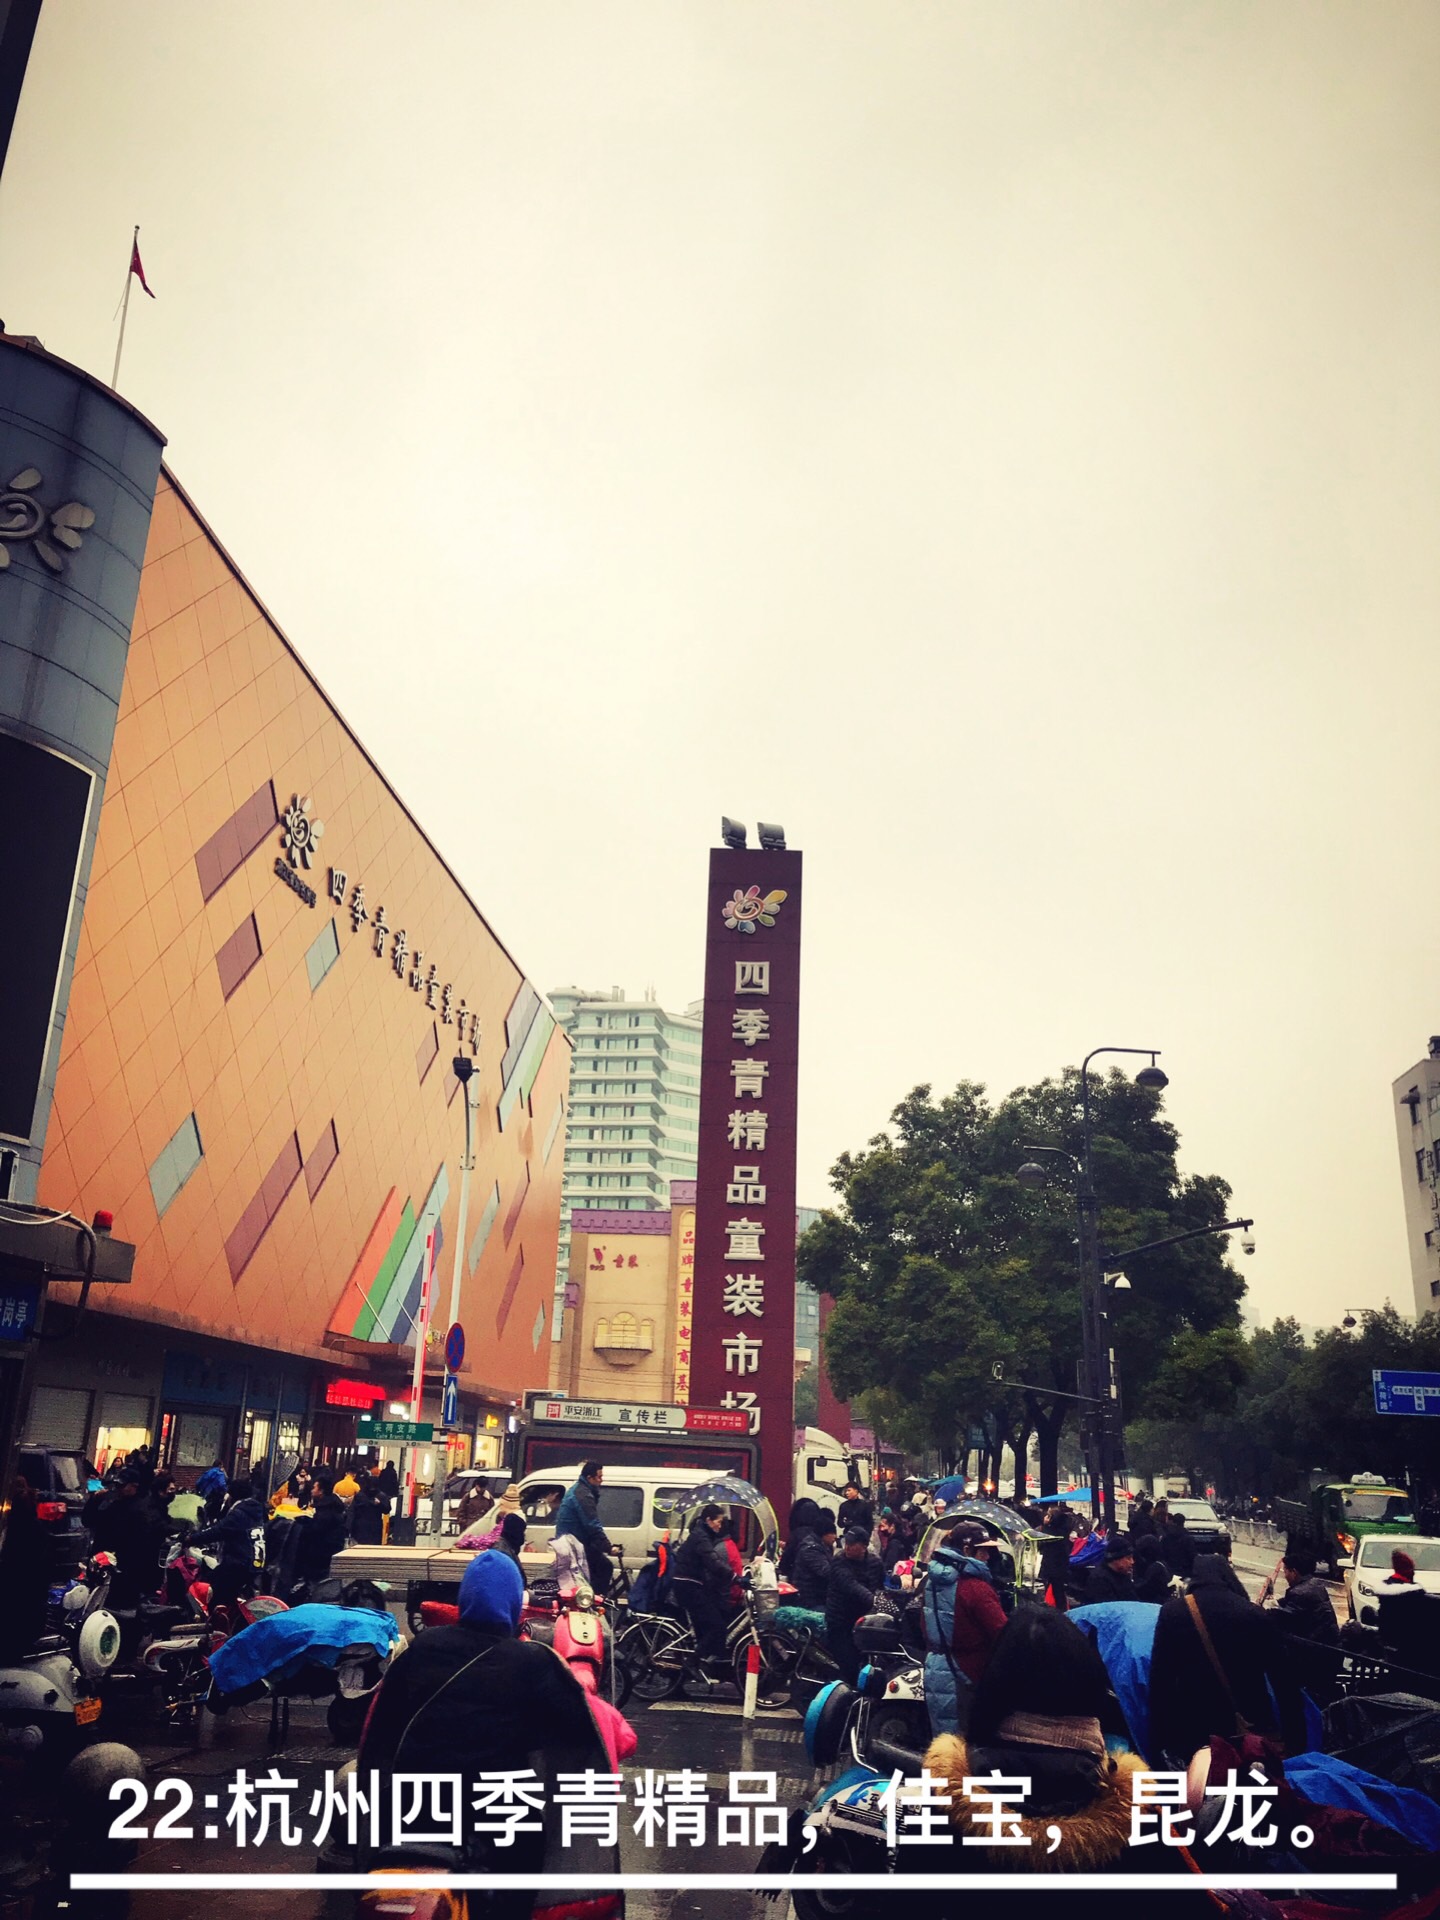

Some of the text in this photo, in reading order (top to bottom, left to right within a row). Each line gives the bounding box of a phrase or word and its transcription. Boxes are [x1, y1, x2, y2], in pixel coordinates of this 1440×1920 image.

[719, 961, 771, 1436] 四季青精品童装市场
[618, 1408, 668, 1425] 宣传栏
[373, 1423, 417, 1434] 采荷支路
